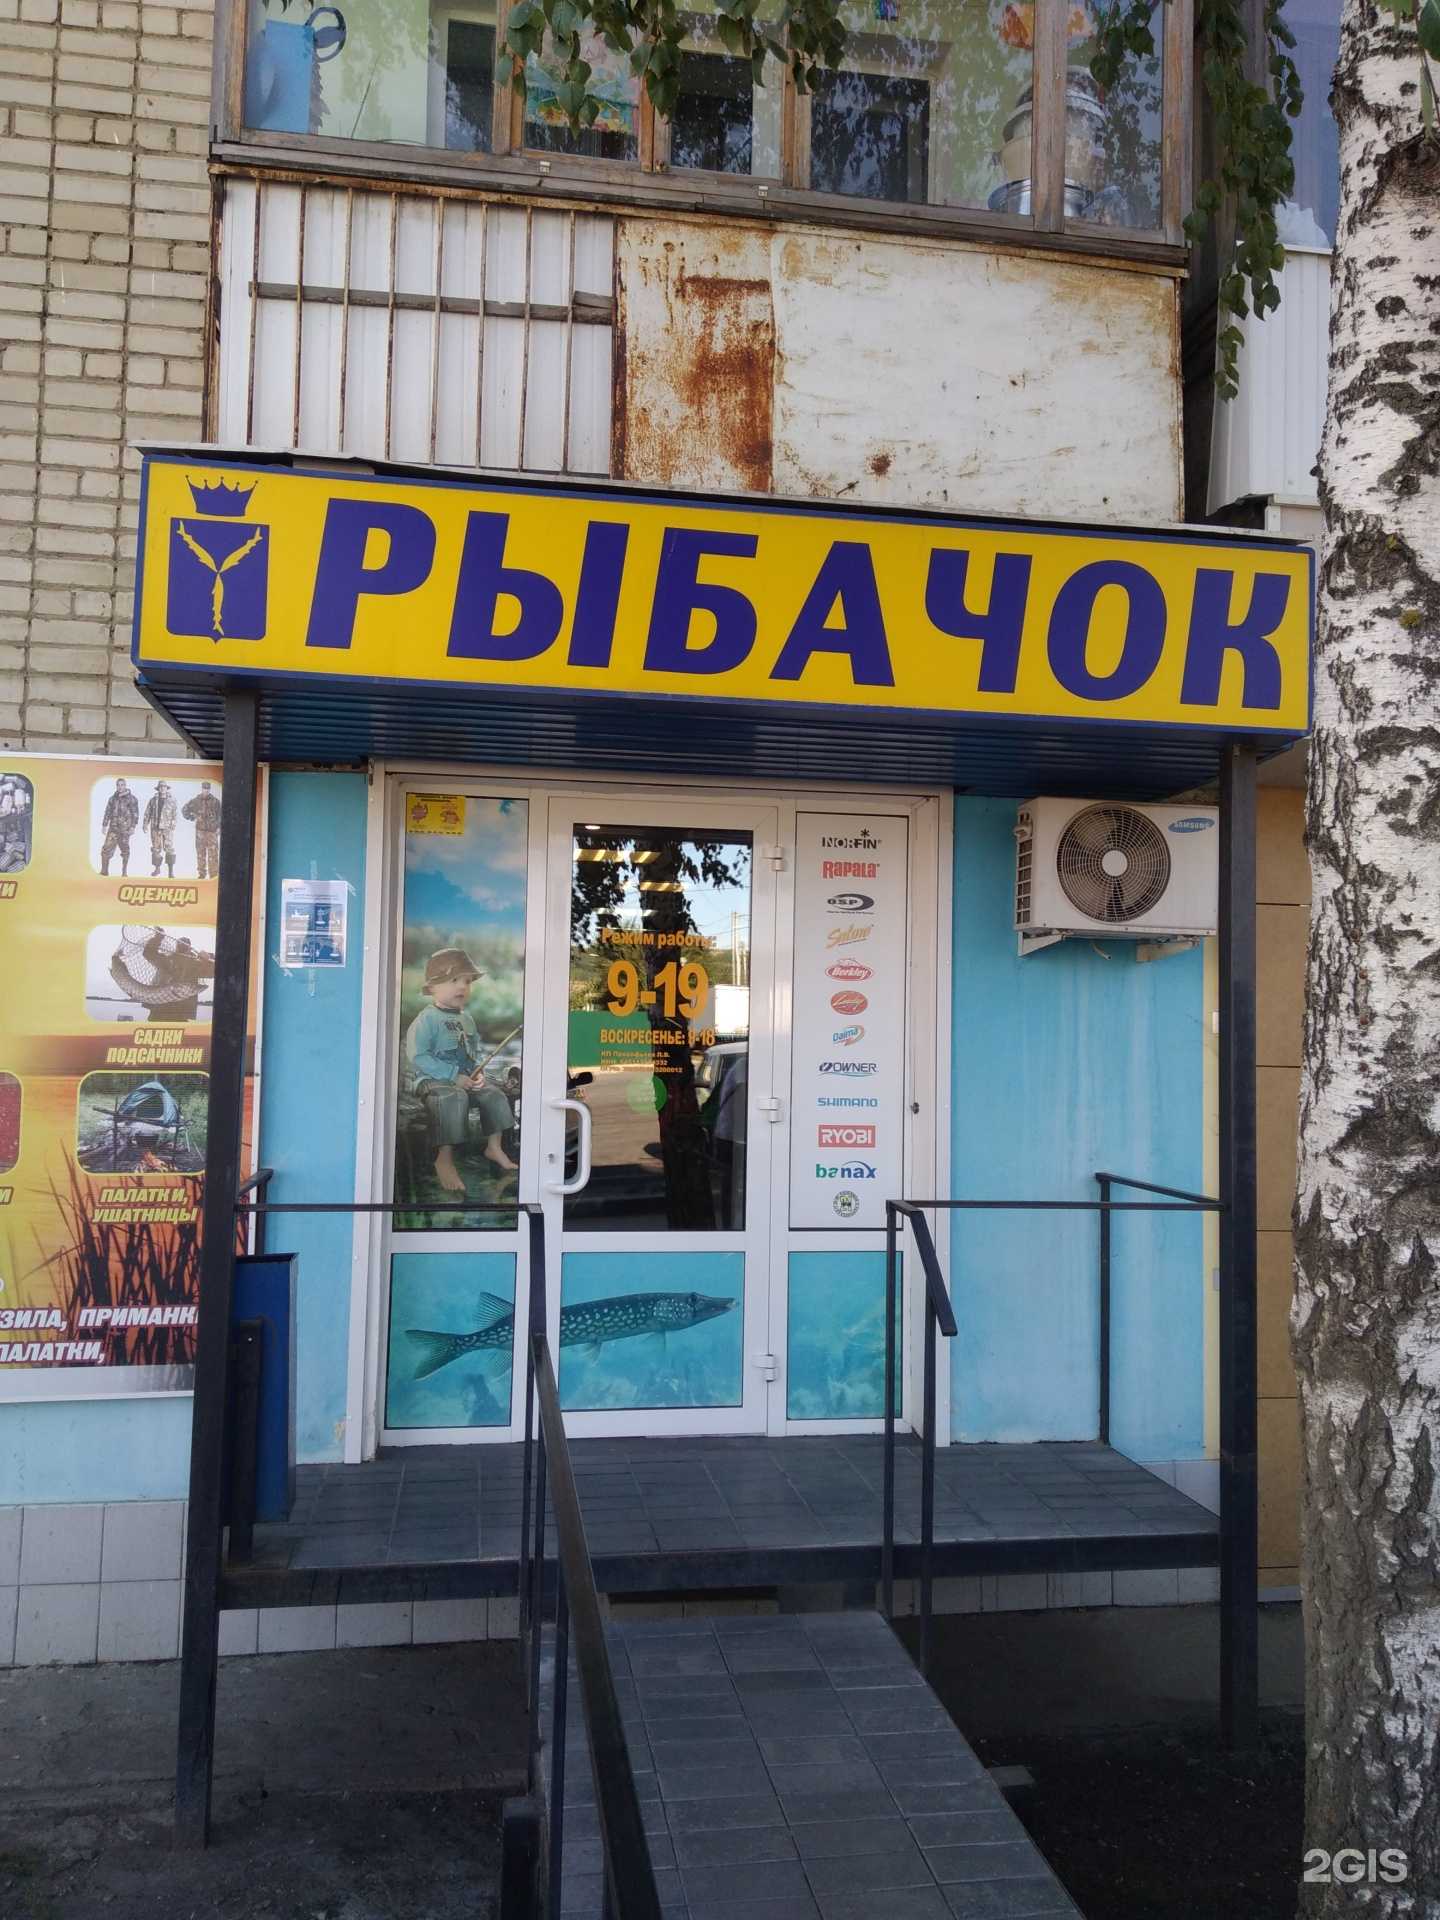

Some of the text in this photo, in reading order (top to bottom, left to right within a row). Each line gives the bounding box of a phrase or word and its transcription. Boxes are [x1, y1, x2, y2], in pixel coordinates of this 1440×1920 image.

[306, 497, 1291, 711] РЫБАЧОК
[821, 836, 877, 849] NORFIN
[120, 886, 196, 904] ОДЕЖДА
[601, 928, 654, 945] Режим
[607, 960, 709, 1020] 9-19
[134, 1028, 184, 1047] САДКИ
[600, 1028, 685, 1045] ВОСКРЕСЕНЬЕ:
[106, 1047, 203, 1066] ПОДСАЧНИКИ
[832, 1062, 877, 1072] OWNER
[817, 1097, 878, 1107] SHIMANO
[821, 1128, 872, 1144] RYOBI
[816, 1163, 876, 1179] banax
[100, 1187, 188, 1205] ПАЛАТКИ,
[92, 1207, 198, 1225] УШАТНИЦЫ
[79, 1305, 199, 1328] ПРИМАНК
